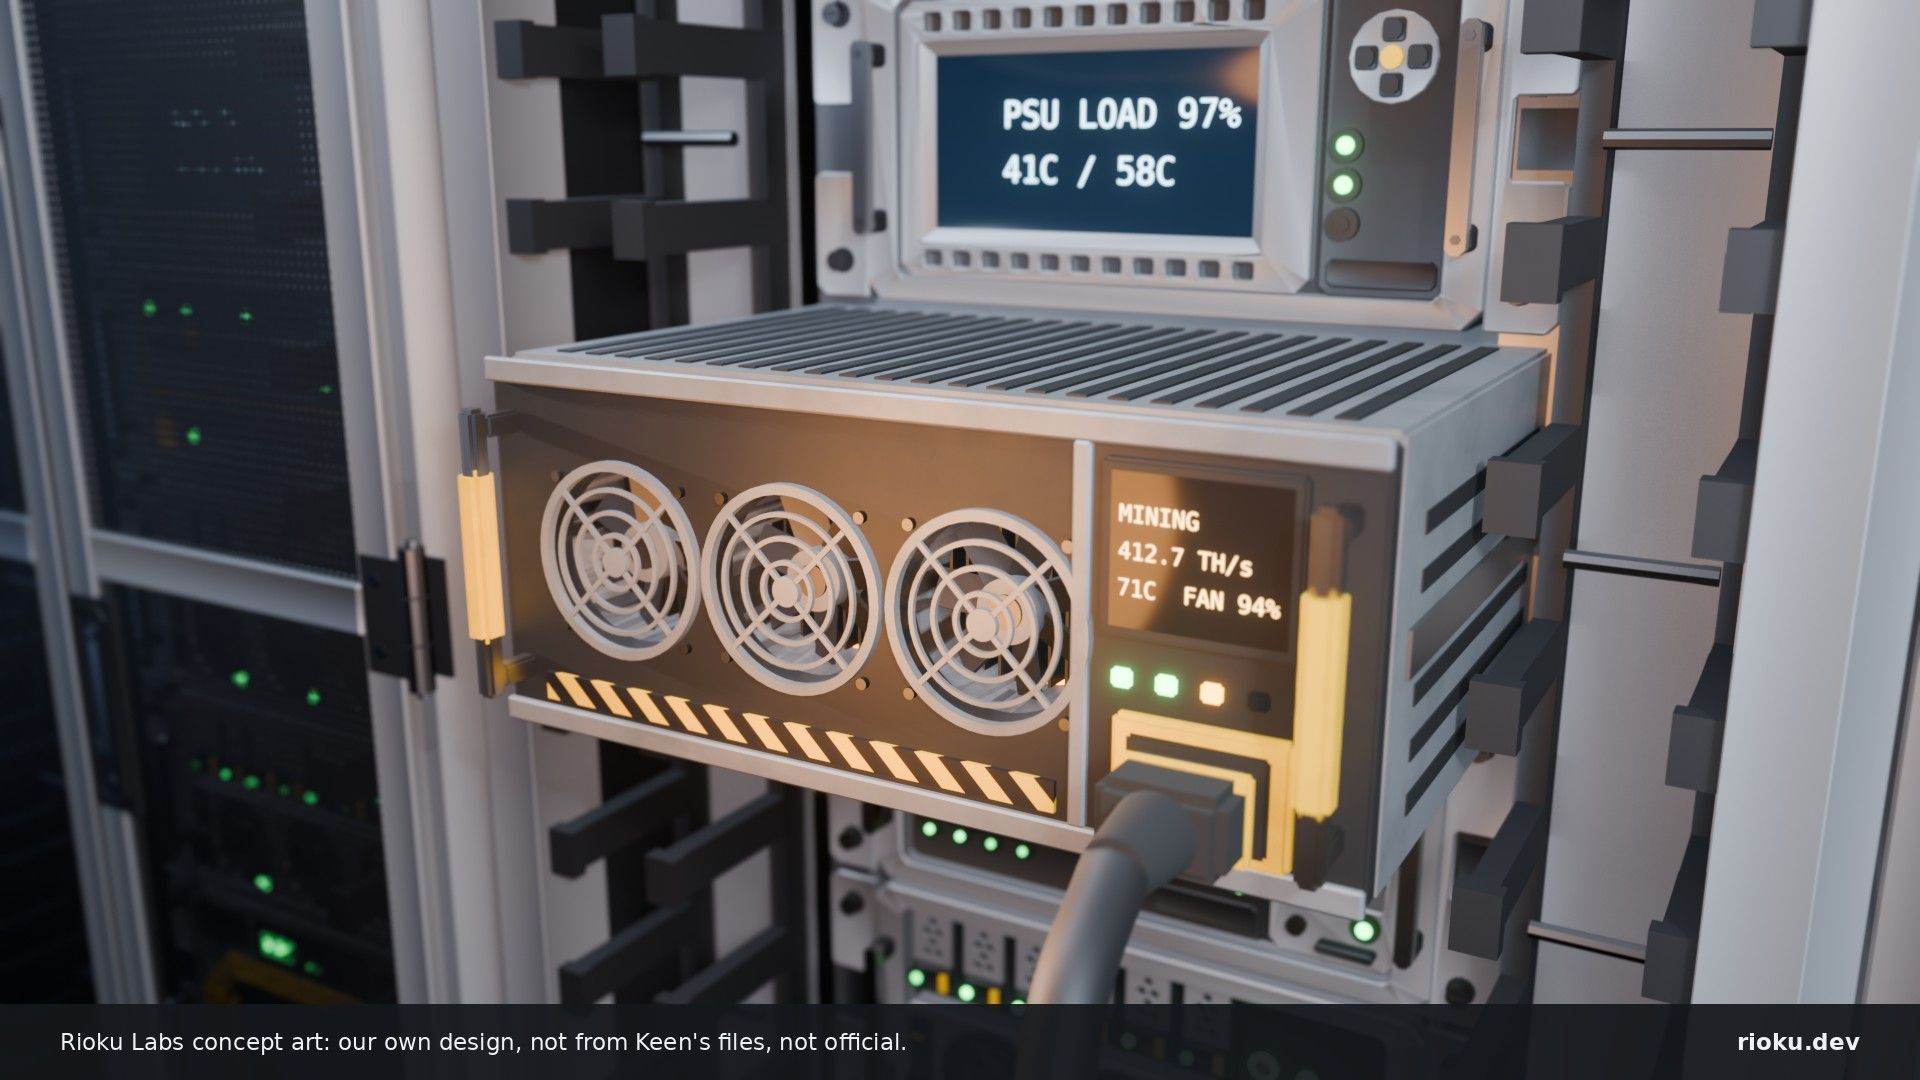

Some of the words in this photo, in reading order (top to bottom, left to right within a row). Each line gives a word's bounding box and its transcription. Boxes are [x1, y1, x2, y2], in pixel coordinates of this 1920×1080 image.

[1003, 98, 1060, 131] PSU
[1078, 97, 1159, 130] LOAD
[1177, 96, 1243, 130] 97%
[1001, 153, 1059, 186] 41C
[1076, 154, 1097, 189] /
[1115, 154, 1177, 187] 58C
[1117, 502, 1200, 533] MINING
[1117, 540, 1185, 568] 412.7
[1196, 549, 1253, 578] TH/s
[1116, 577, 1158, 602] 71C
[1183, 586, 1225, 612] FAN
[1237, 594, 1282, 621] 94%
